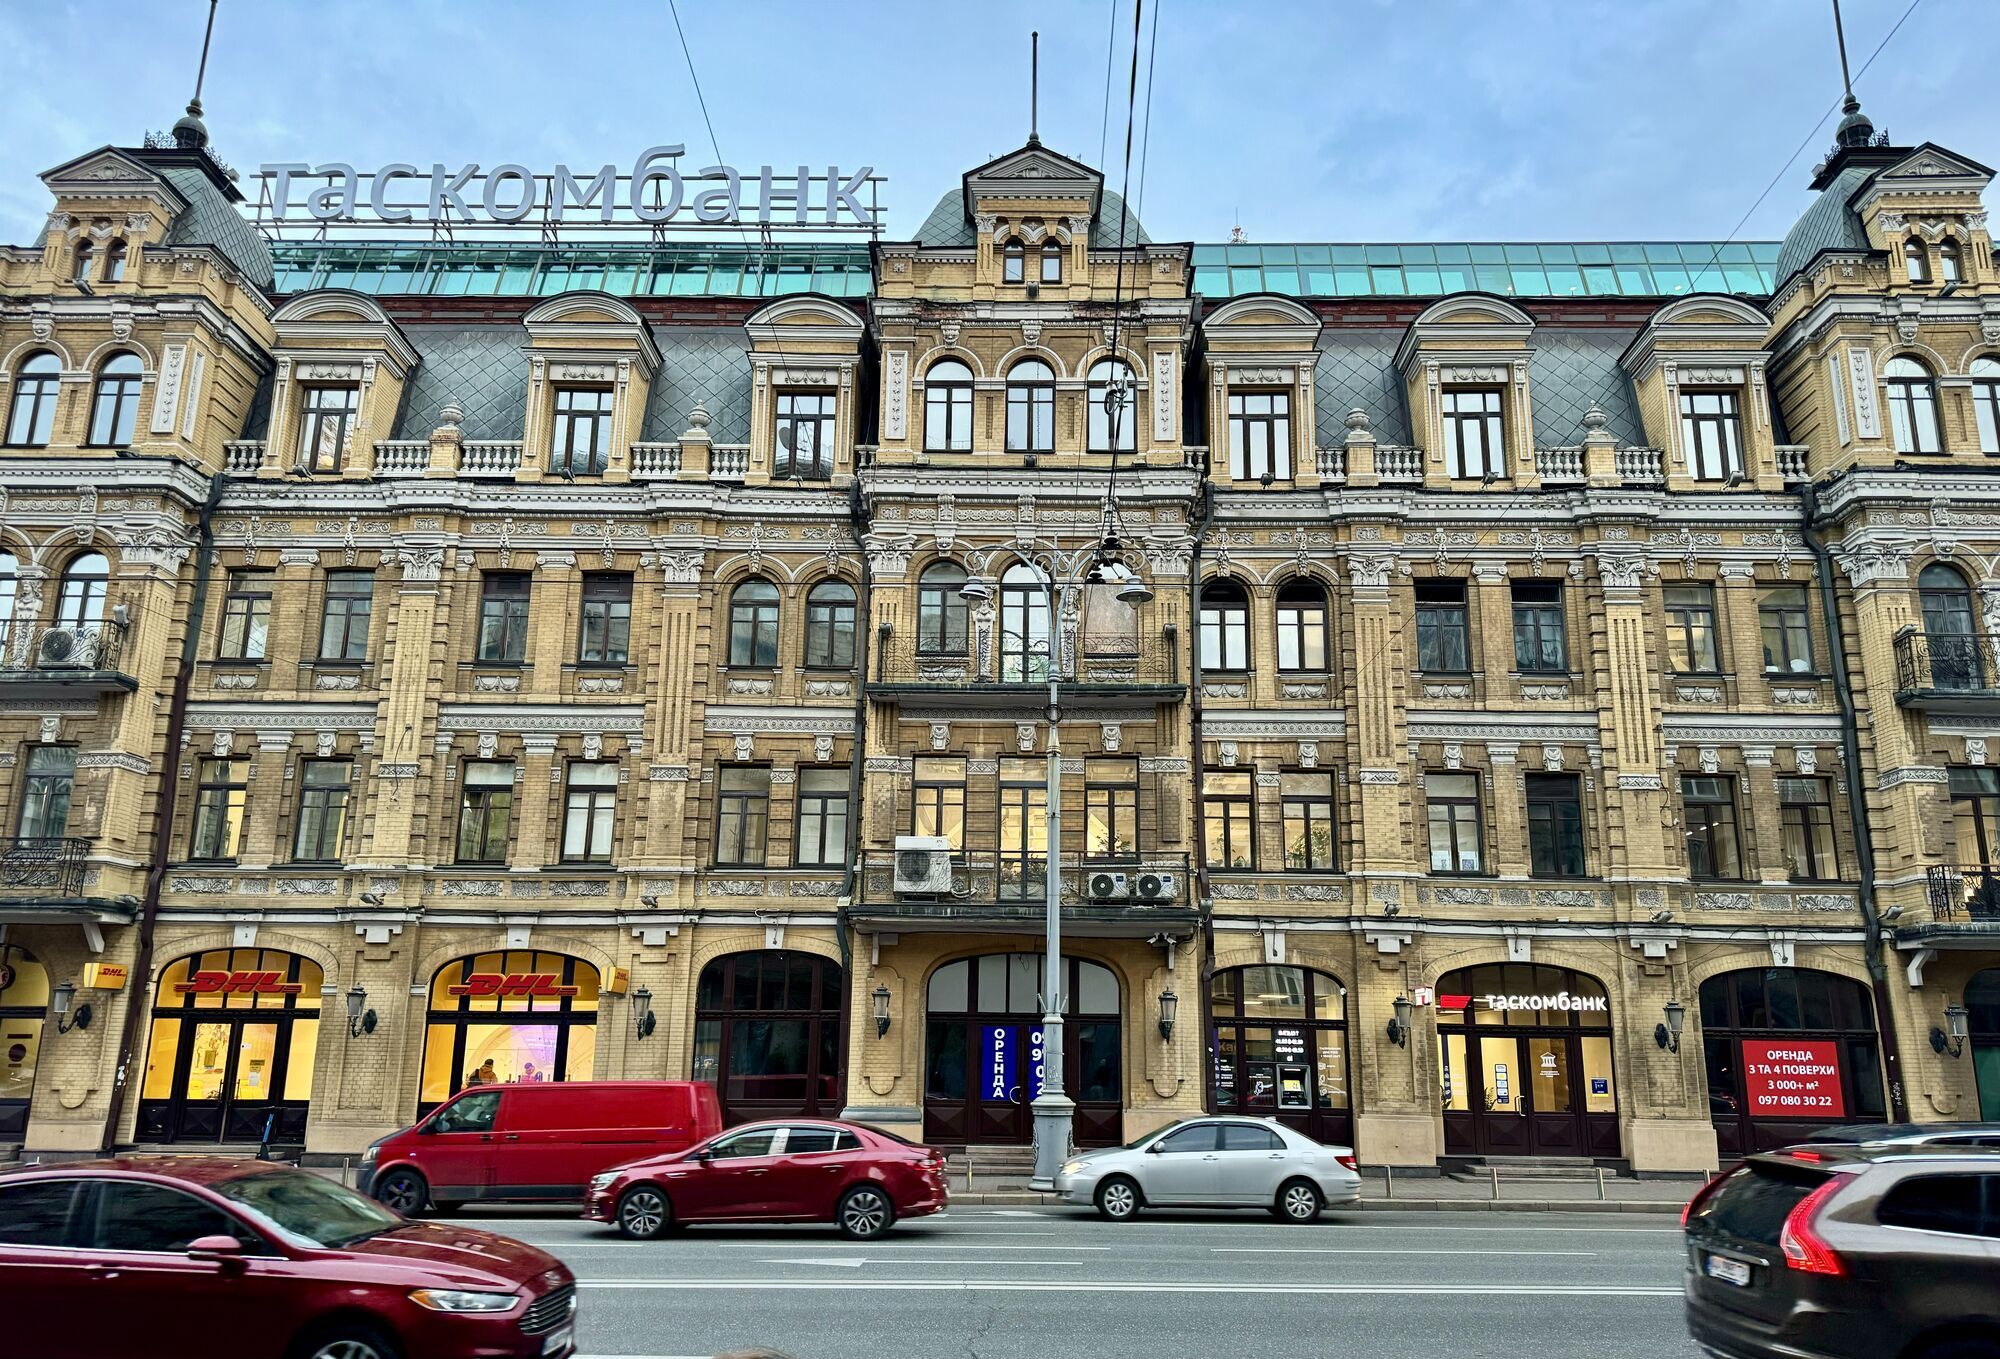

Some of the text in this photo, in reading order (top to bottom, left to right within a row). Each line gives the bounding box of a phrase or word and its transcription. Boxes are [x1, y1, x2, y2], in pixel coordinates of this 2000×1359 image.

[260, 143, 874, 224] таскомбанк
[101, 967, 125, 977] DHL
[186, 969, 288, 994] DHL
[461, 972, 565, 996] DHL
[1485, 991, 1608, 1011] таскомбанк
[992, 1028, 1006, 1098] ОРЕНДА
[1766, 1050, 1814, 1062] ОРЕНДА
[1748, 1064, 1835, 1075] 3 ТА 4 ПОВЕРХИ
[1767, 1080, 1775, 1090] 3
[1776, 1080, 1804, 1090] 000+
[1758, 1095, 1833, 1106] 097 080 30 22
